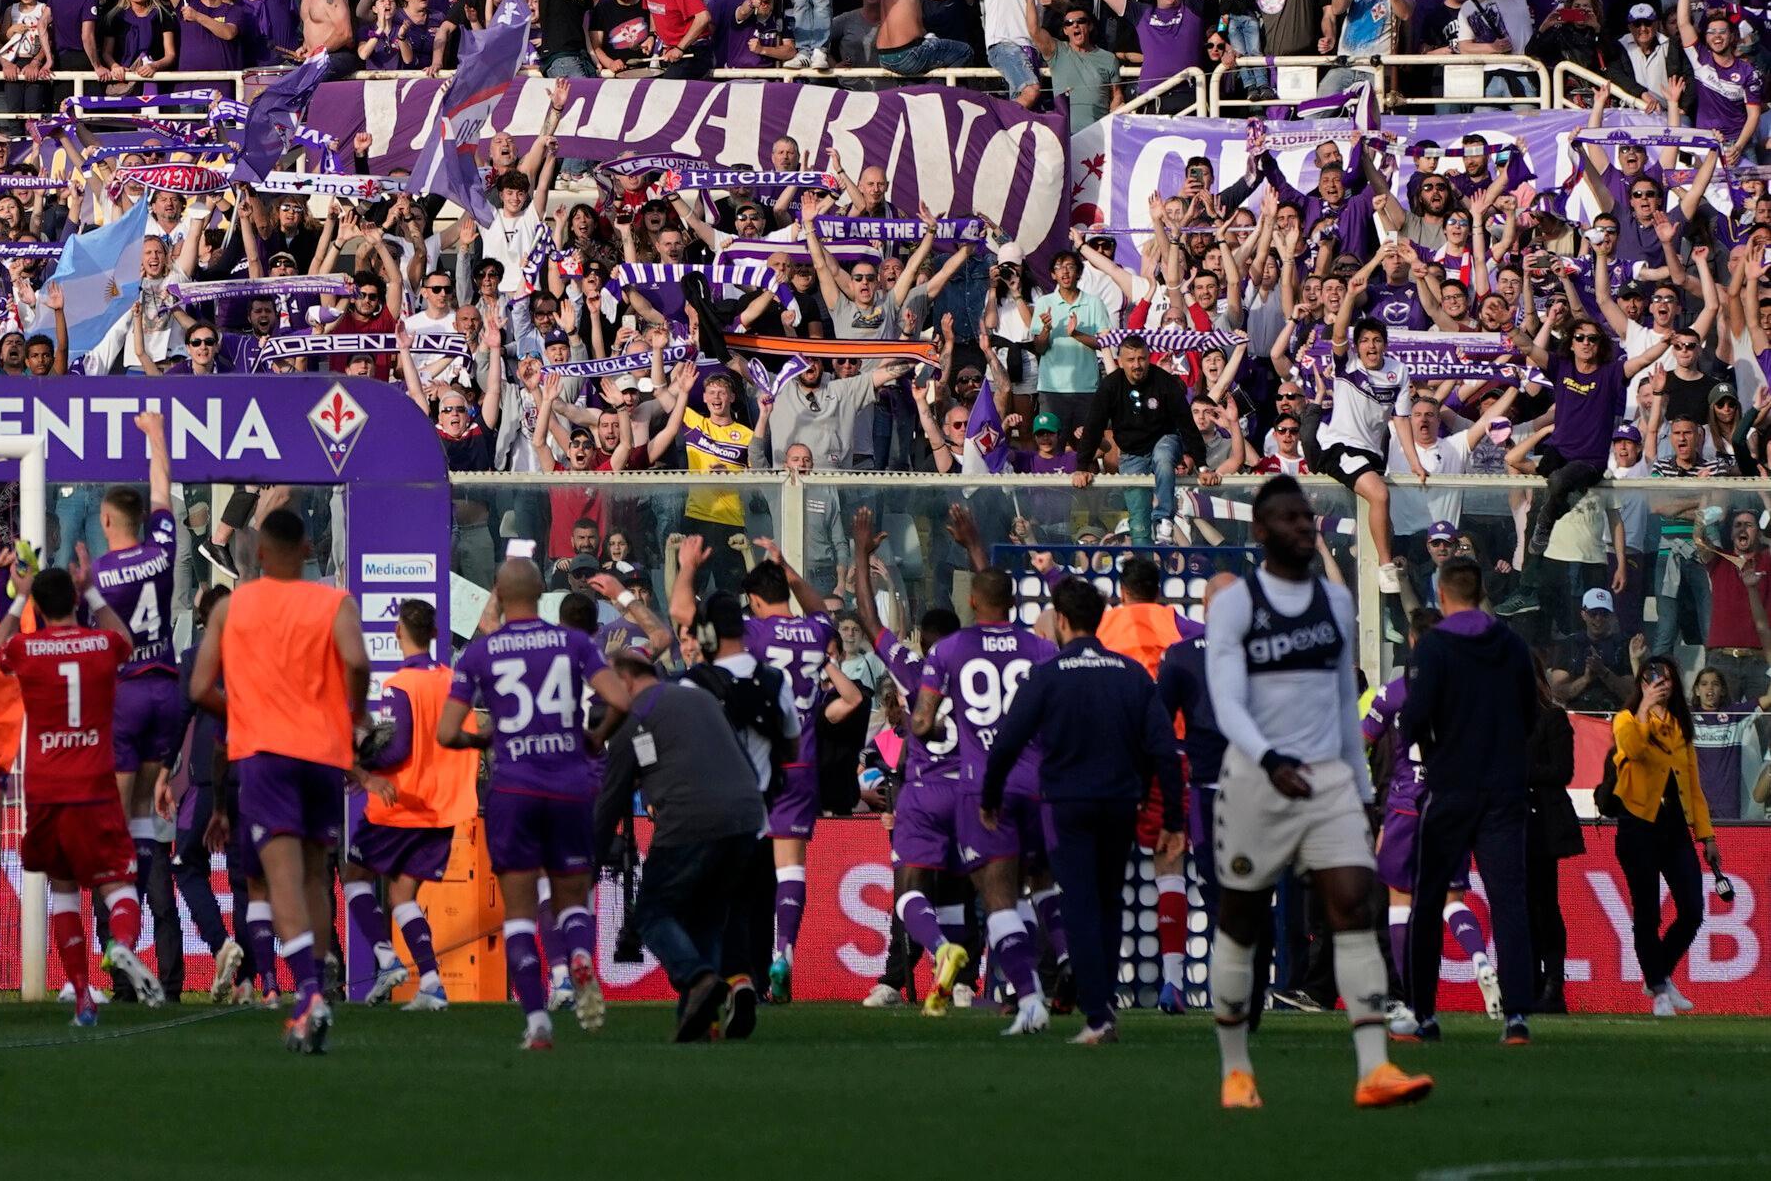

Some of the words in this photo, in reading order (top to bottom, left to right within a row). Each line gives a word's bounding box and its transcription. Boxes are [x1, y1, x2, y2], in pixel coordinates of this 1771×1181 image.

[1, 177, 65, 188] FIORENTINA
[689, 169, 816, 188] Firenze
[819, 220, 847, 239] WE
[849, 220, 880, 239] ARE
[885, 221, 915, 239] THE
[918, 221, 956, 239] FRM
[586, 356, 637, 375] VIOLA
[1383, 350, 1454, 365] NTINA
[1408, 362, 1494, 377] ORENTINA
[696, 439, 741, 460] Mediacom
[364, 562, 427, 576] Mediacom
[129, 581, 160, 642] 4
[486, 631, 569, 655] AMRABAT
[774, 625, 819, 644] SOTTIL
[1247, 621, 1337, 665] gpexe
[24, 635, 109, 658] TERRACCIANO
[982, 635, 1018, 654] IGOR
[1058, 656, 1127, 672] FIORENTINA
[57, 661, 81, 729] 1
[490, 653, 578, 733] 34
[38, 729, 101, 755] prima
[504, 731, 577, 761] prima
